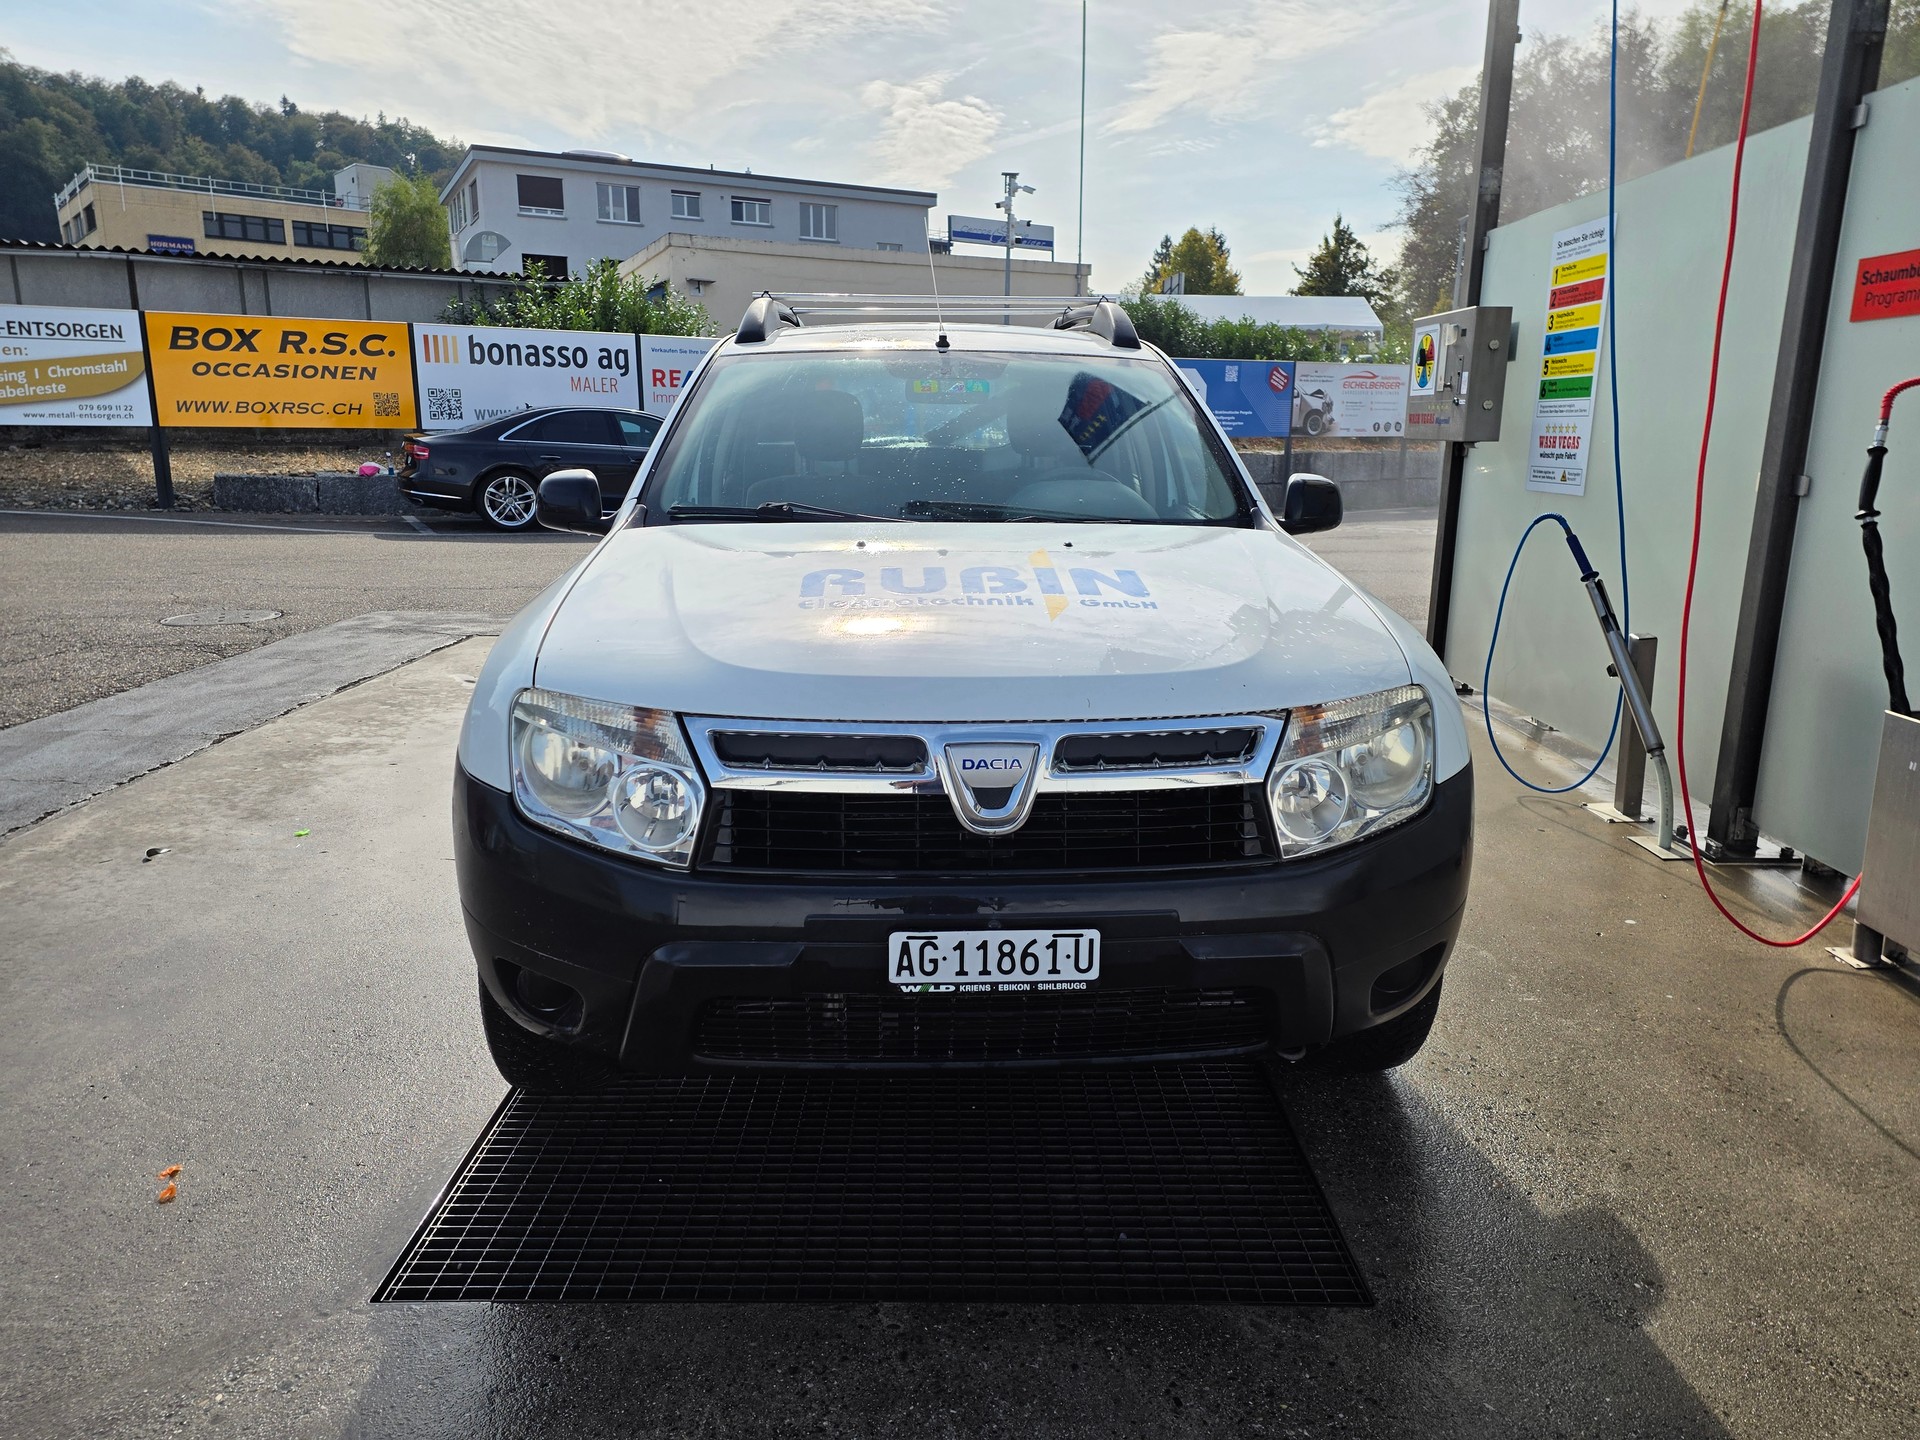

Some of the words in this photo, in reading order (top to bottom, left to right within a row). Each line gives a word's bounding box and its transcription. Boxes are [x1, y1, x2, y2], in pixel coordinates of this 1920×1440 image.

[1551, 292, 1556, 307] 2
[1864, 289, 1920, 308] Program
[1549, 315, 1554, 330] 3
[168, 326, 262, 353] BOX
[278, 330, 396, 358] R.S.C.
[468, 334, 588, 369] bonasso
[598, 346, 630, 377] ag
[47, 359, 128, 378] Chromstahl
[191, 361, 377, 381] OCCASIONEN
[1543, 360, 1549, 375] 5
[570, 376, 618, 393] MALER
[1342, 381, 1400, 389] EICHELBERGER
[1541, 382, 1546, 397] 6
[78, 404, 94, 412] 079
[97, 404, 113, 412] 699
[176, 400, 362, 416] WWW.BOXRSC.CH
[23, 411, 134, 421] www.metall-entsorgen.ch
[1539, 436, 1556, 449] WASH
[1558, 436, 1581, 449] VEGAS
[1080, 598, 1158, 610] GmbH
[962, 758, 1022, 770] DACIA
[959, 984, 991, 992] KRIENS
[1038, 982, 1086, 990] SIHLBRUGG
